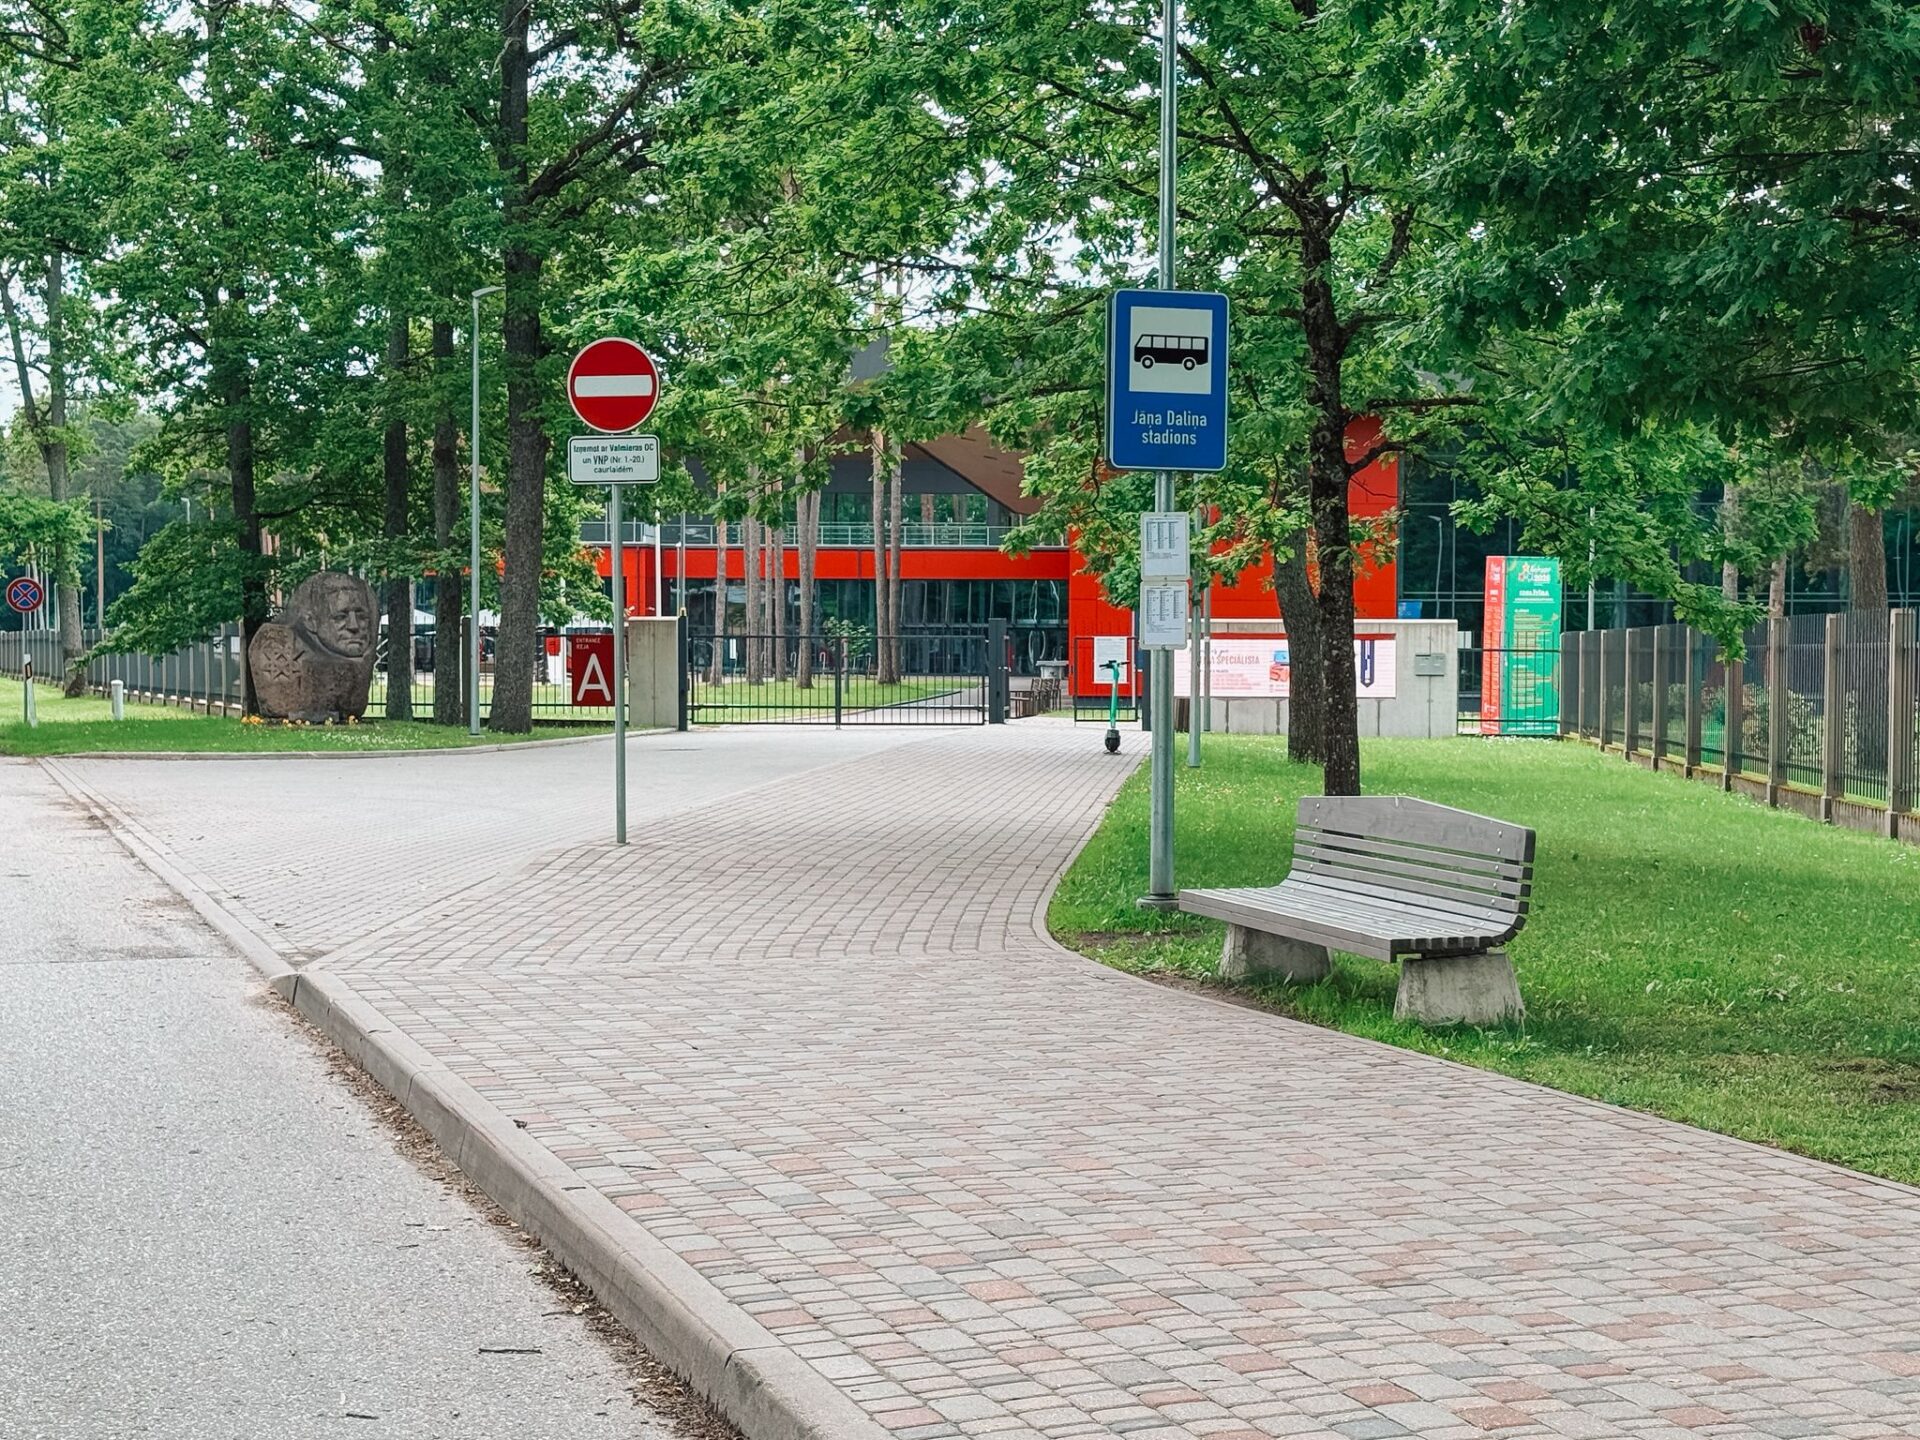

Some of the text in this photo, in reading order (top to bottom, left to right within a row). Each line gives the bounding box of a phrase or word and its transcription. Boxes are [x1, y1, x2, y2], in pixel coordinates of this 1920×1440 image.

[1131, 409, 1207, 430] Jāņa Daliņa
[1142, 429, 1197, 445] stadions
[609, 444, 643, 453] Valmieras
[593, 455, 609, 465] VNP
[576, 653, 612, 702] A
